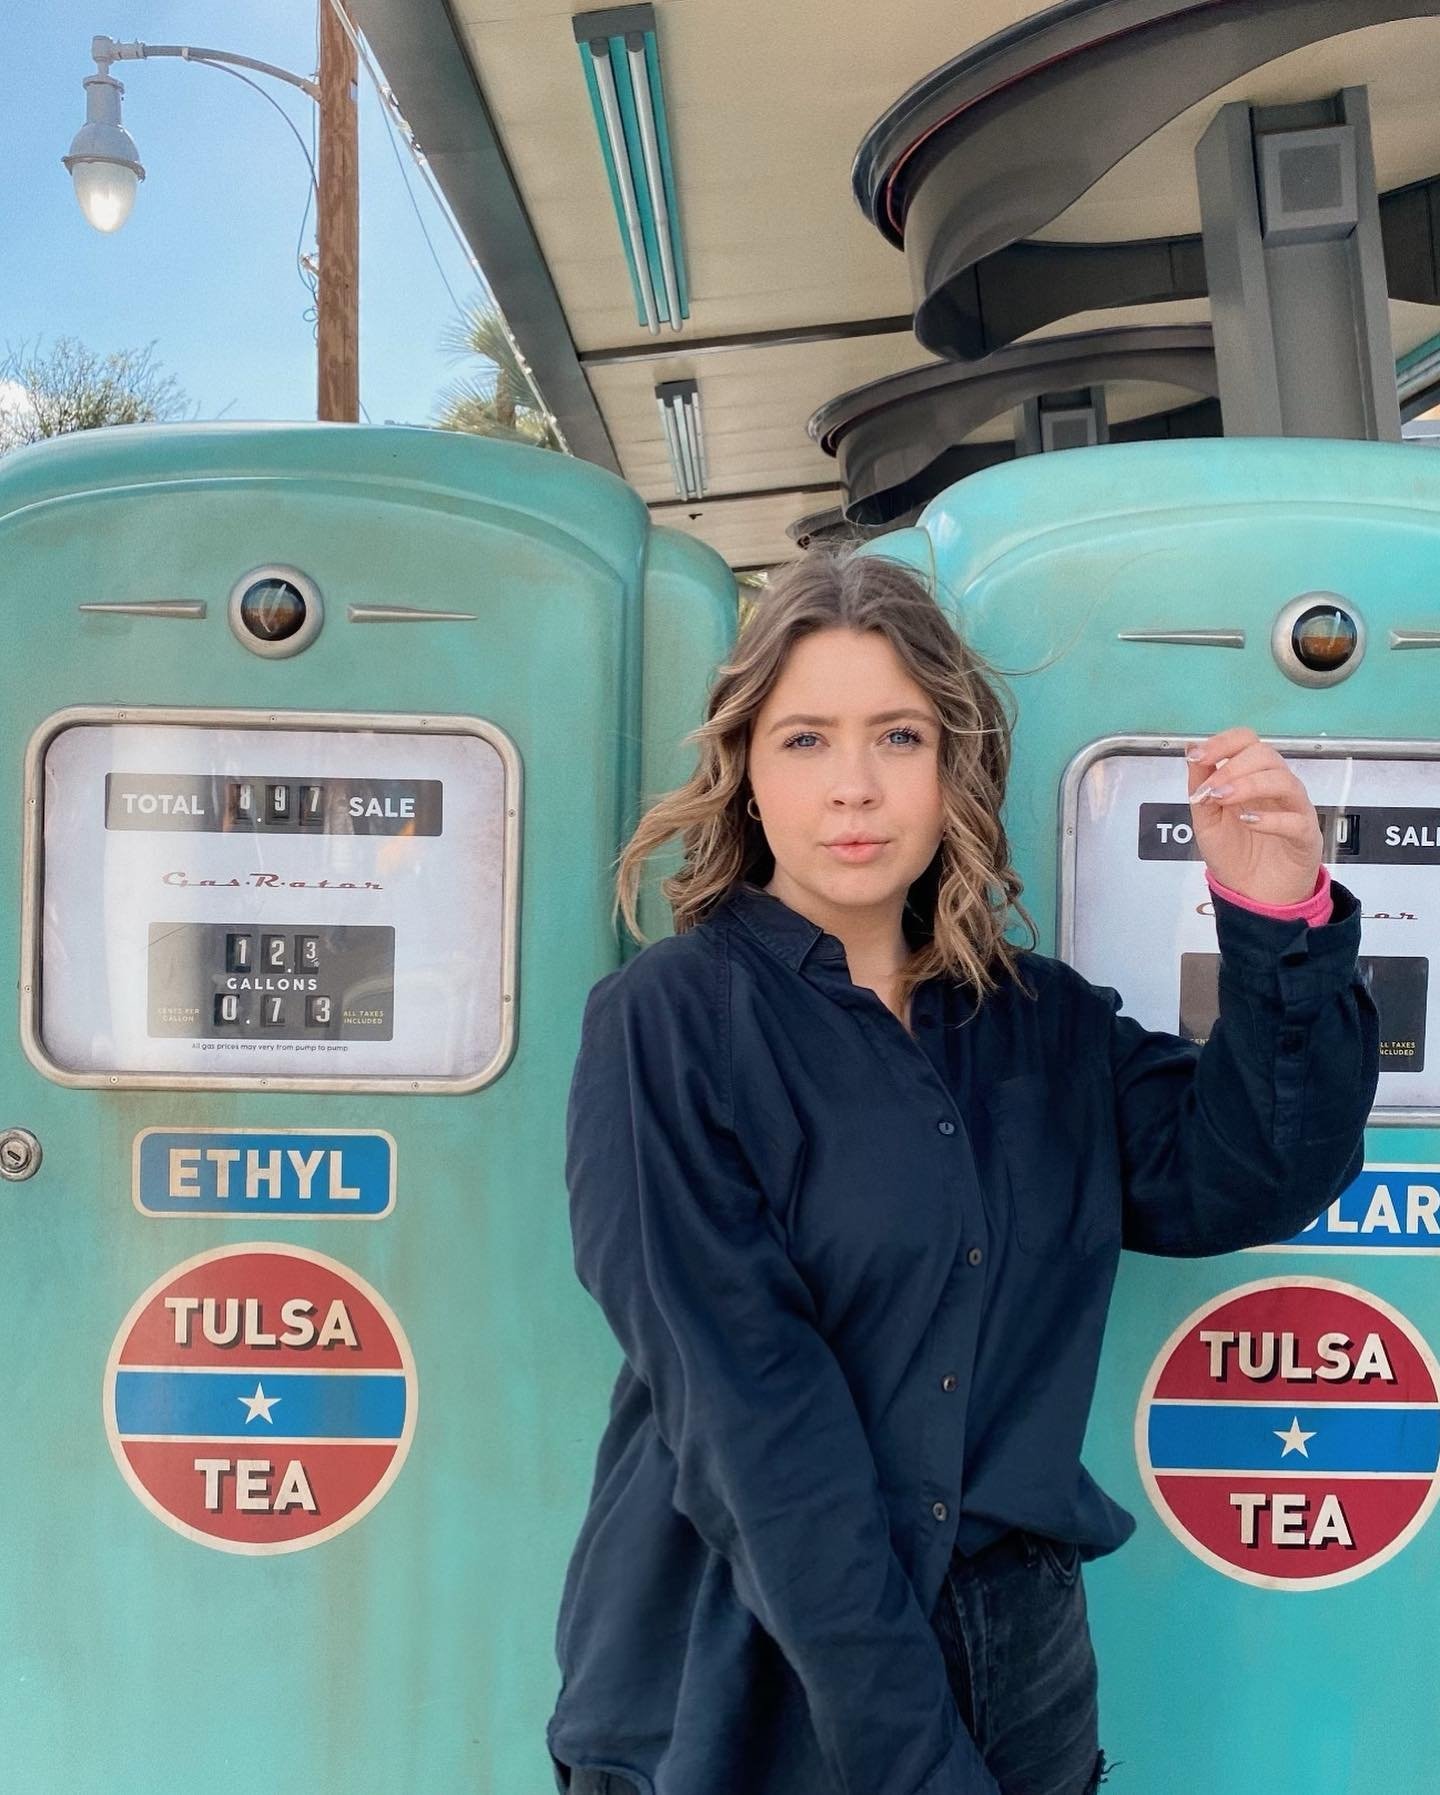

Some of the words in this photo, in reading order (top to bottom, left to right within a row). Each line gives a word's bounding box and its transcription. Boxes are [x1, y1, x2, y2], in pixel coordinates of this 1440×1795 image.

[122, 793, 205, 816] TOTAL
[349, 796, 416, 818] SALE
[1385, 825, 1440, 847] SAL
[226, 977, 318, 991] GALLONS
[359, 1010, 385, 1018] TAXES
[1391, 1041, 1416, 1049] TAXES
[168, 1148, 361, 1201] ETHYL
[165, 1296, 362, 1350] TULSA
[1199, 1331, 1397, 1383] TULSA
[194, 1457, 319, 1513] TEA
[1229, 1493, 1356, 1548] TEA
